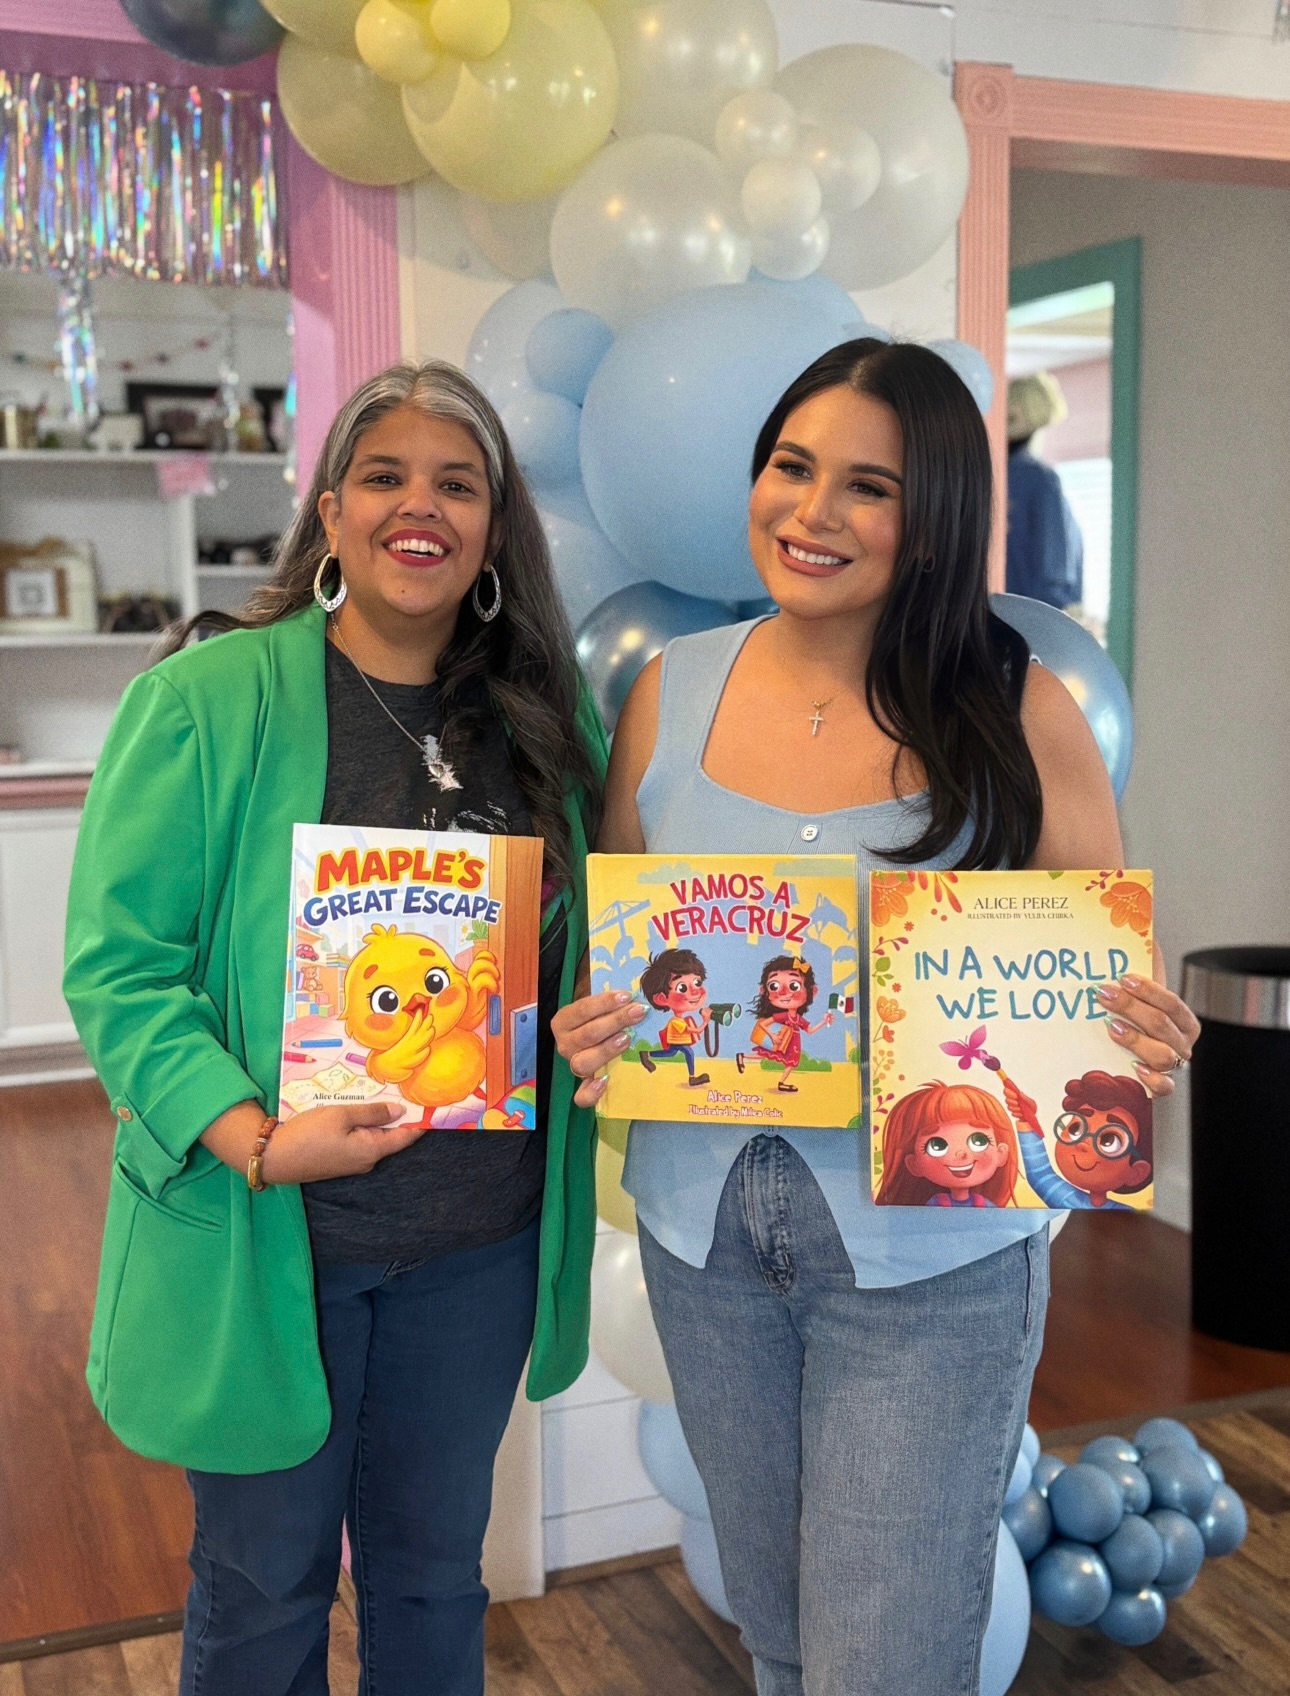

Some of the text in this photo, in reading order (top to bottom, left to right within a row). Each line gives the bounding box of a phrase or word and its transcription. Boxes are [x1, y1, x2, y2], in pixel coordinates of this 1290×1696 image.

[316, 848, 486, 893] MAPLE'S
[303, 886, 501, 927] GREAT ESCAPE
[669, 873, 791, 909] VAMOS A
[974, 897, 1069, 910] ALICE PEREZ
[651, 905, 811, 943] VERACRUZ
[967, 912, 1012, 920] ILLUSTRATED
[1013, 912, 1021, 920] BY
[915, 945, 1129, 981] IN A WORLD
[936, 986, 1107, 1020] WE LOVE
[689, 1104, 728, 1116] Illustrated
[729, 1106, 740, 1118] by
[741, 1106, 763, 1117] Milica
[707, 1090, 763, 1103] Alice Perez
